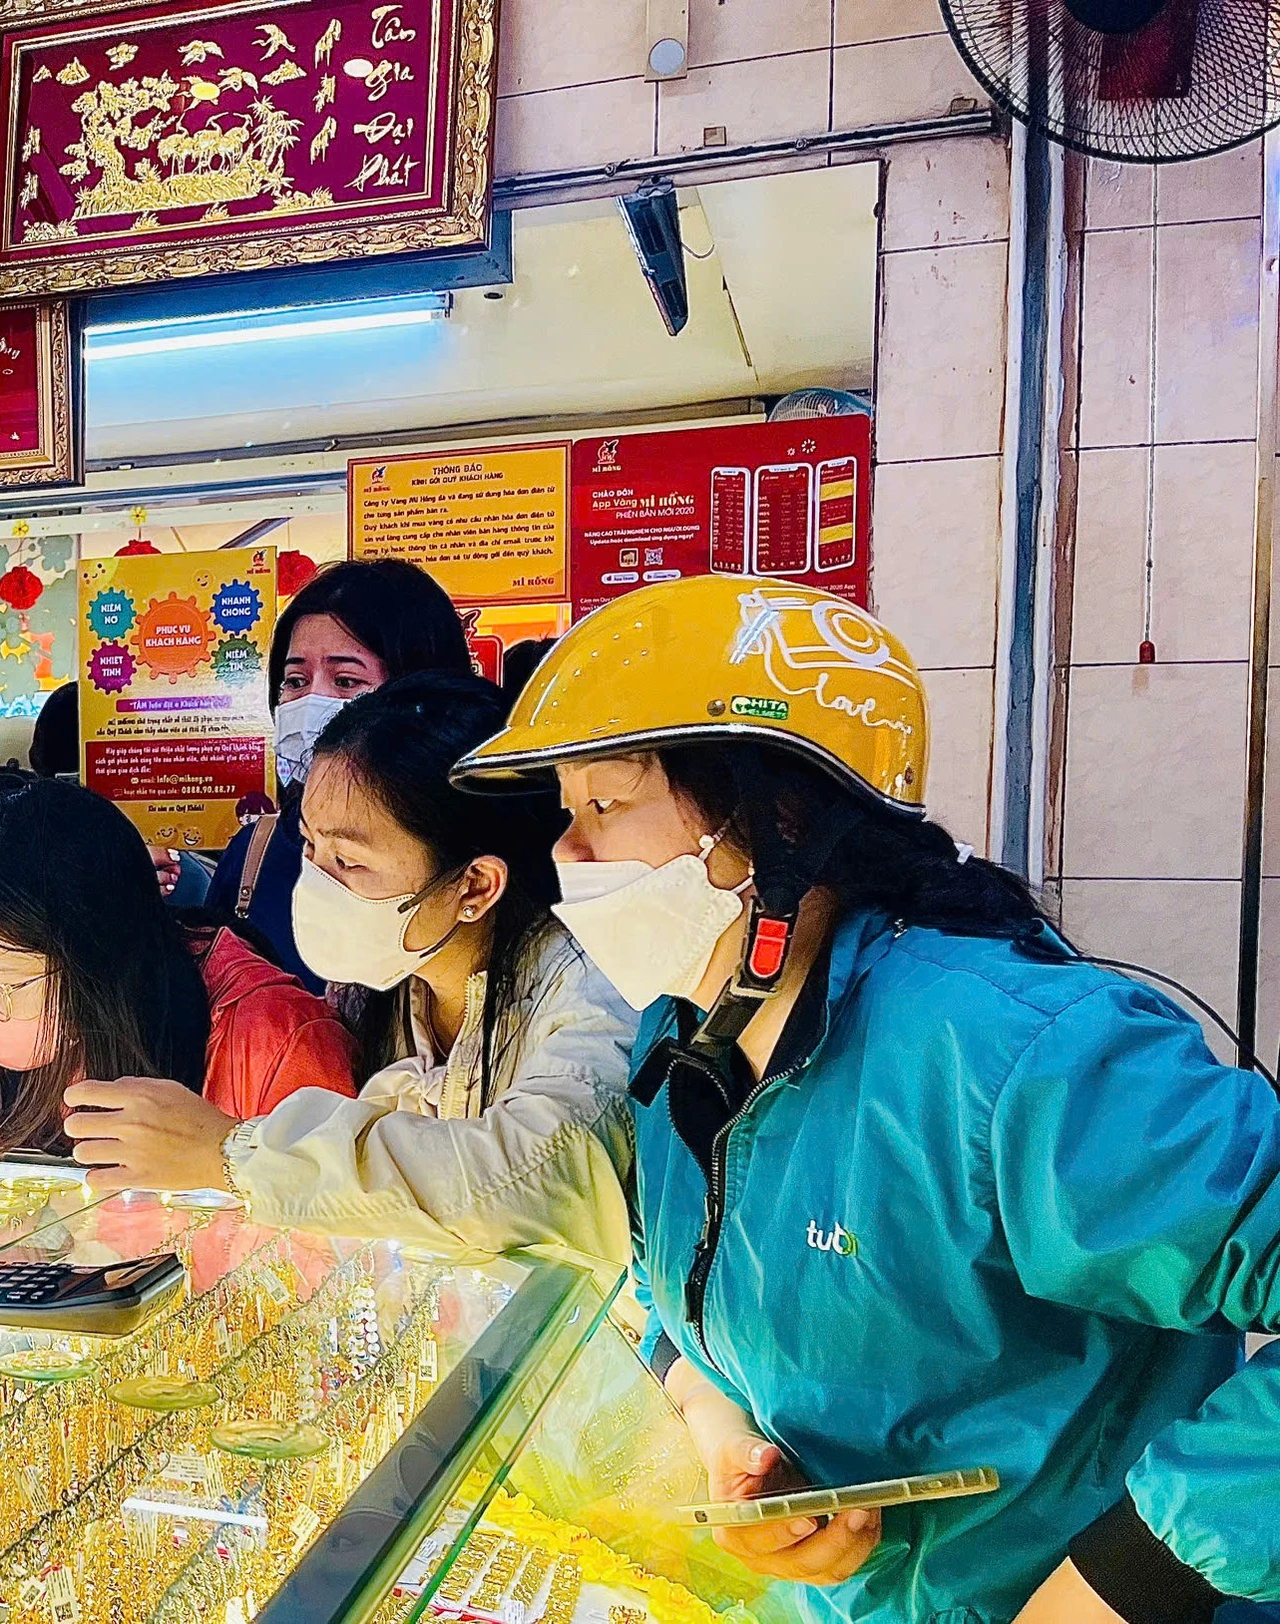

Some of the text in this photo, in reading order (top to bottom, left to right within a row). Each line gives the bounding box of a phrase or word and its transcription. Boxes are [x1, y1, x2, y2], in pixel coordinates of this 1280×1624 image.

[433, 463, 483, 475] THÔNG BÁO
[459, 473, 483, 482] KHÁCH
[484, 472, 504, 480] HÀNG
[592, 489, 615, 499] CHÀO
[592, 500, 611, 510] App
[613, 498, 638, 508] Vàng
[639, 507, 657, 518] BẢN
[657, 507, 675, 517] MỚI
[675, 507, 695, 516] 2020
[379, 522, 398, 530] khách
[527, 575, 555, 586] HỒNG
[221, 596, 251, 606] NHANH
[230, 661, 243, 672] TIN
